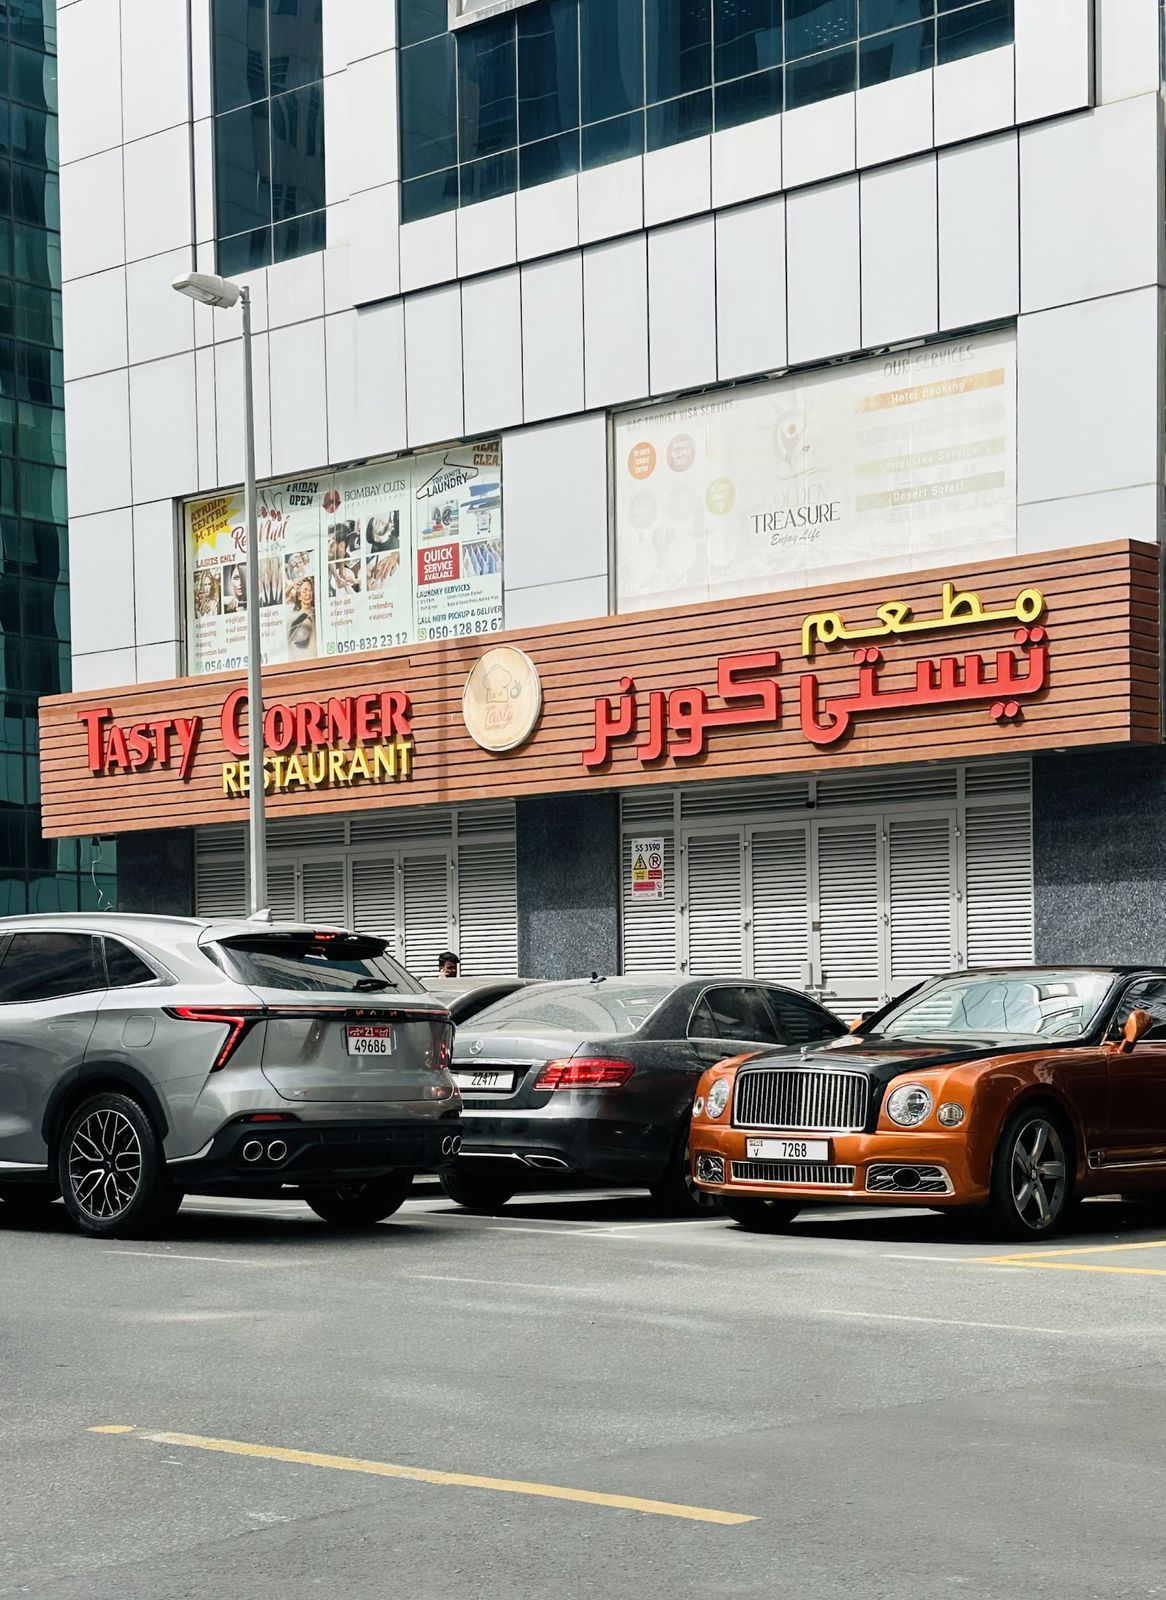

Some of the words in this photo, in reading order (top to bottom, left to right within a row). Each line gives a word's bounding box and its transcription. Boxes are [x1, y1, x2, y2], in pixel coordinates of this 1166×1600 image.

[884, 358, 909, 377] OUR
[914, 344, 975, 371] SERVICES
[891, 391, 918, 403] Hotel
[922, 382, 965, 399] Booking
[679, 406, 698, 420] VISA
[287, 482, 319, 493] FRIDAY
[344, 484, 381, 502] BOMBAY
[383, 479, 406, 493] CUTS
[427, 472, 468, 498] LAUNDRY
[289, 495, 314, 506] OPEN
[191, 498, 226, 522] ATRIUM
[192, 505, 228, 533] CENTRE
[750, 500, 841, 534] TREASURE
[770, 533, 798, 546] Enjoy
[799, 528, 821, 542] Life
[423, 546, 453, 563] QUICK
[423, 560, 454, 574] SERVICE
[424, 570, 454, 581] AVAILABLE
[416, 587, 443, 598] LAUNDRY
[444, 583, 471, 594] SERVICES
[802, 582, 1046, 657] مطعم
[429, 622, 472, 640] 050-128
[475, 619, 488, 633] 82
[338, 636, 378, 653] 050-832
[380, 634, 393, 647] 23
[396, 631, 408, 645] 12
[582, 651, 781, 767] كورنر
[77, 707, 201, 779] TASTY
[220, 687, 413, 755] CORNER
[364, 1027, 374, 1037] 21
[354, 1039, 387, 1053] 49686
[471, 1072, 499, 1086] 22477
[753, 1147, 759, 1157] V
[782, 1142, 807, 1157] 7268
